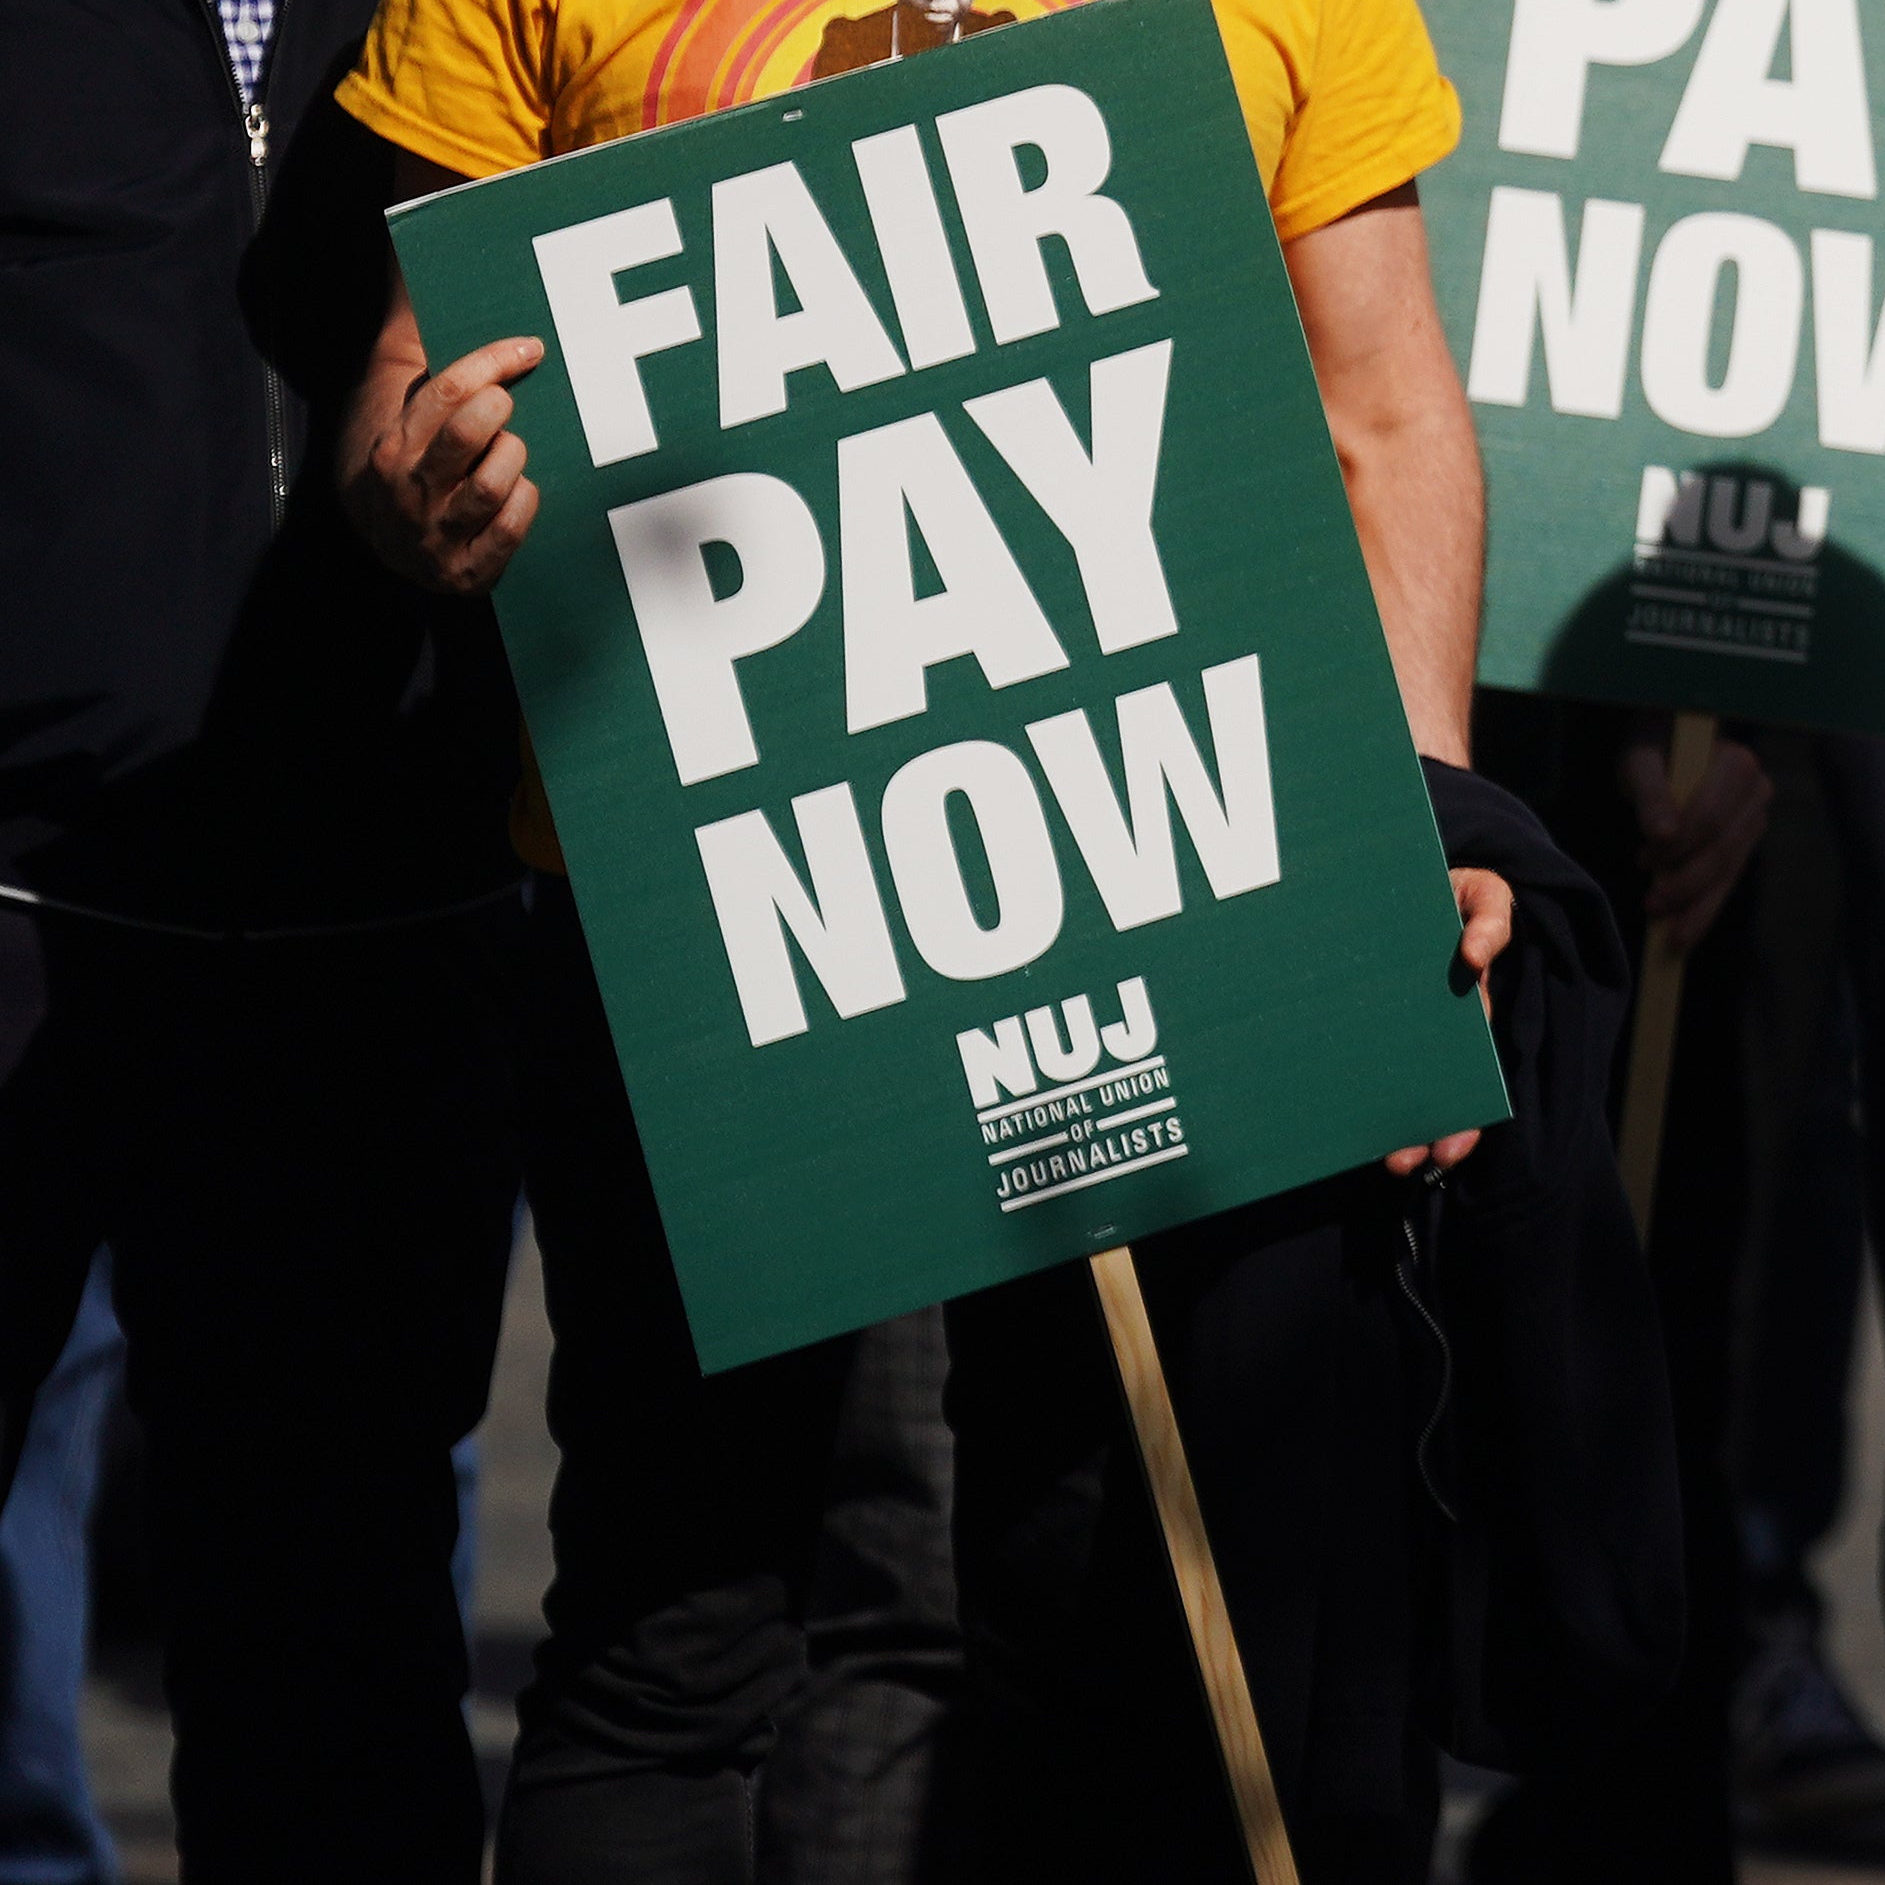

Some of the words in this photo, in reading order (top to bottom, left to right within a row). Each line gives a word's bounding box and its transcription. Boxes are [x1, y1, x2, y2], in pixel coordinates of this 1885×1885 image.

[532, 83, 1160, 468] FAIR
[607, 337, 1179, 787] PAY
[1635, 464, 1832, 561] NUJ
[694, 654, 1281, 1048] NOW
[955, 975, 1158, 1110] NUJ
[980, 1095, 1094, 1144] NATIONAL
[1099, 1067, 1171, 1107] UNION
[996, 1116, 1185, 1198] JOURNALISTS
[1069, 1119, 1095, 1143] OF
